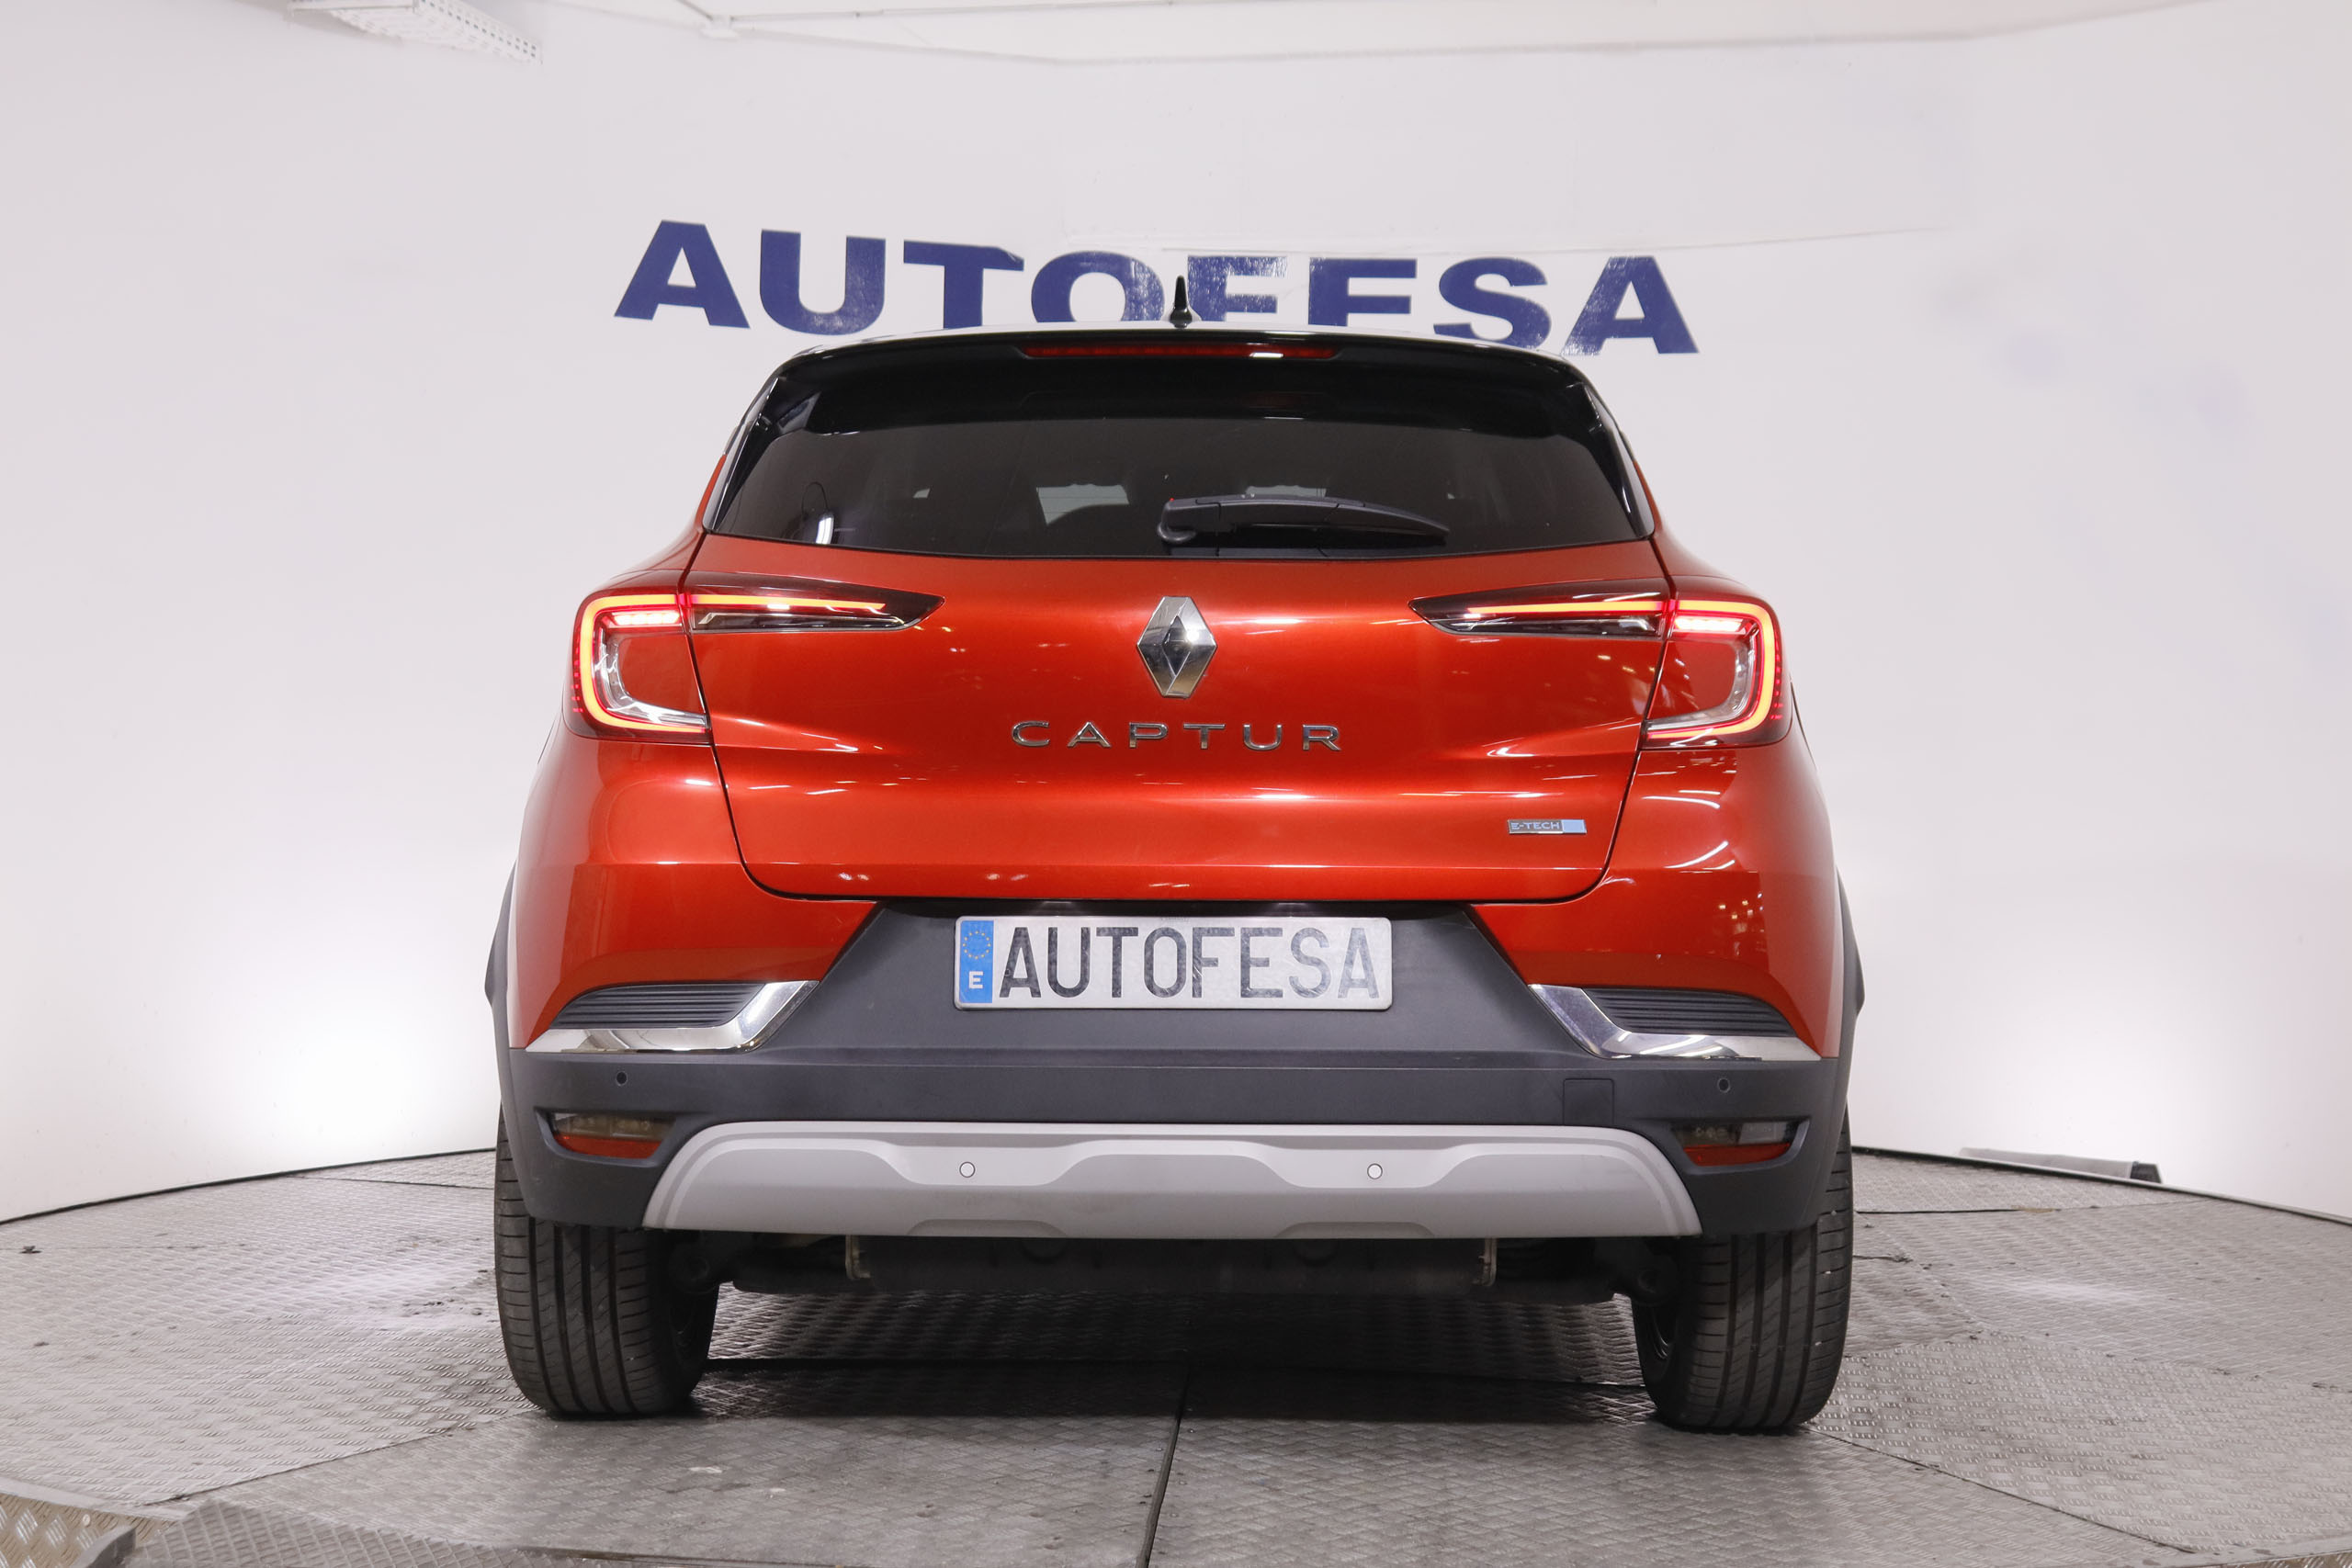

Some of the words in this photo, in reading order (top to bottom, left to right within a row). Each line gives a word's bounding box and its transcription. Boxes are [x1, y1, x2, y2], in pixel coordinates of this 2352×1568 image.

[615, 220, 1699, 355] AUTOFESA
[1012, 720, 1341, 751] CAPTUR
[1510, 821, 1560, 830] E-TECH
[999, 926, 1380, 998] AUTOFESA
[968, 971, 984, 989] E
